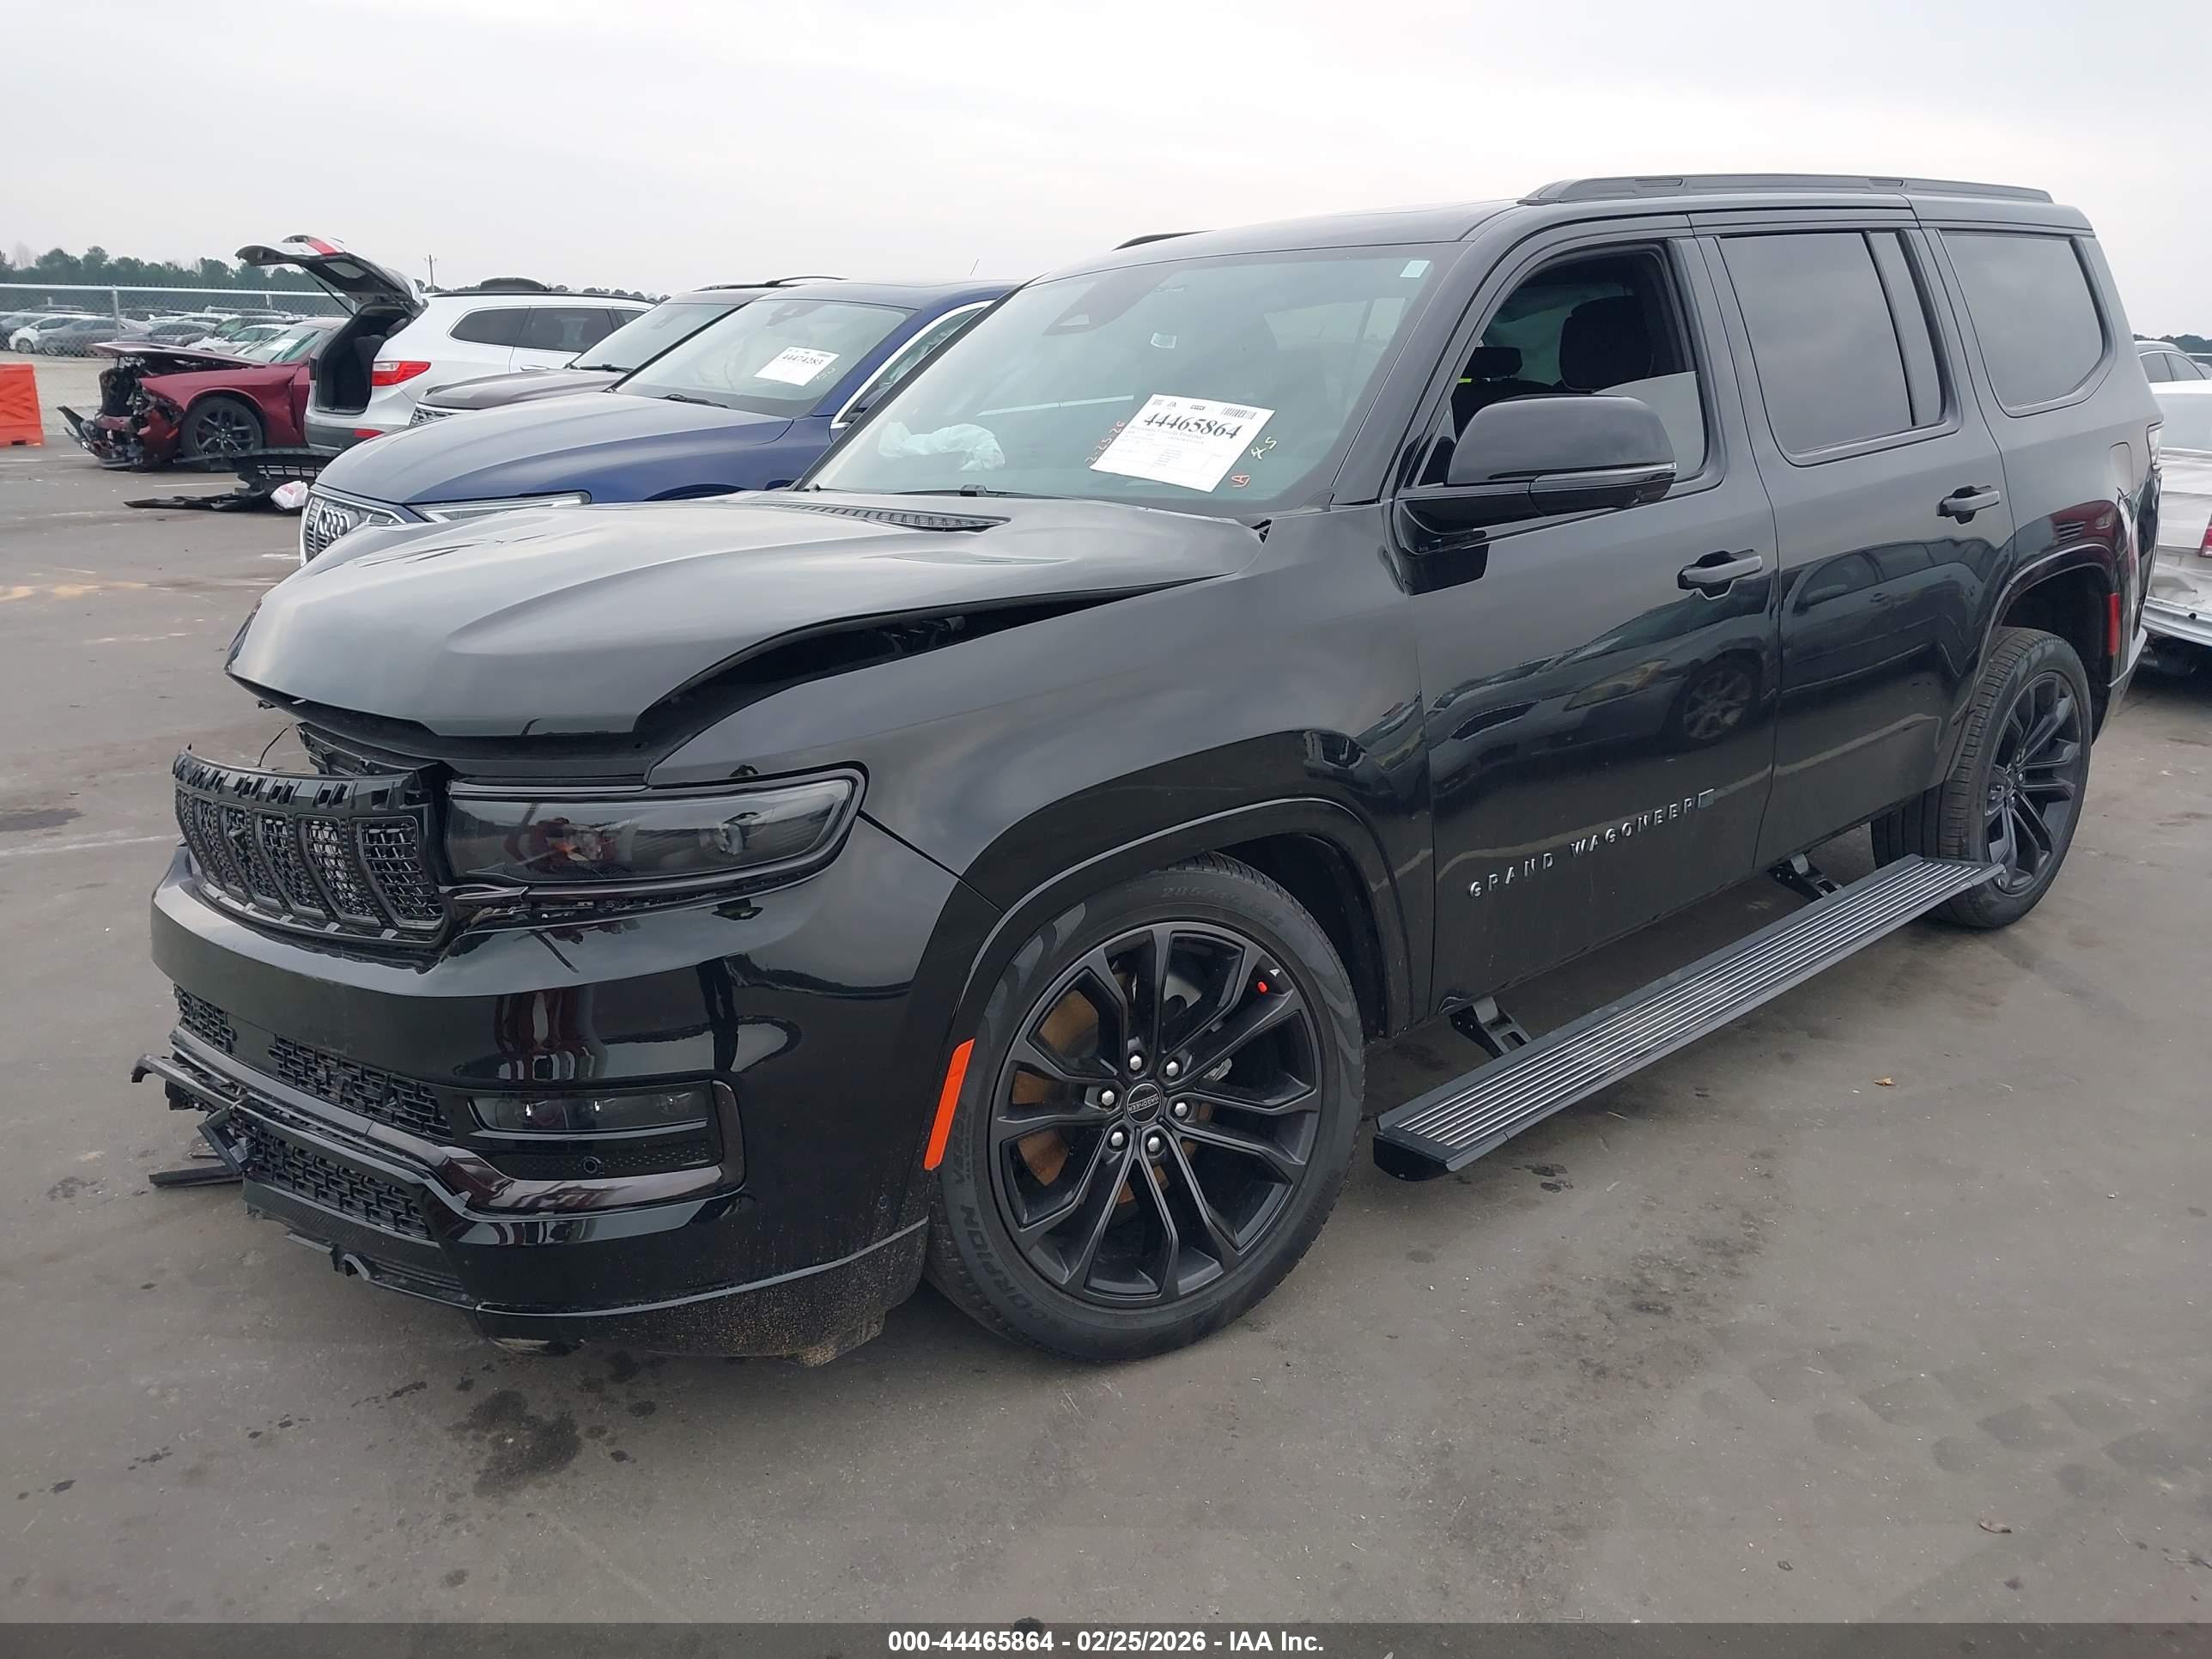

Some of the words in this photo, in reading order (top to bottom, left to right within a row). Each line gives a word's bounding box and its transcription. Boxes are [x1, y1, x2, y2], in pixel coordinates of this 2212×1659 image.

[1143, 412, 1243, 440] 44465864
[1469, 852, 1554, 897] GRAND
[1570, 797, 1693, 859] WAGONEER
[1128, 1095, 1159, 1111] WAGONEER
